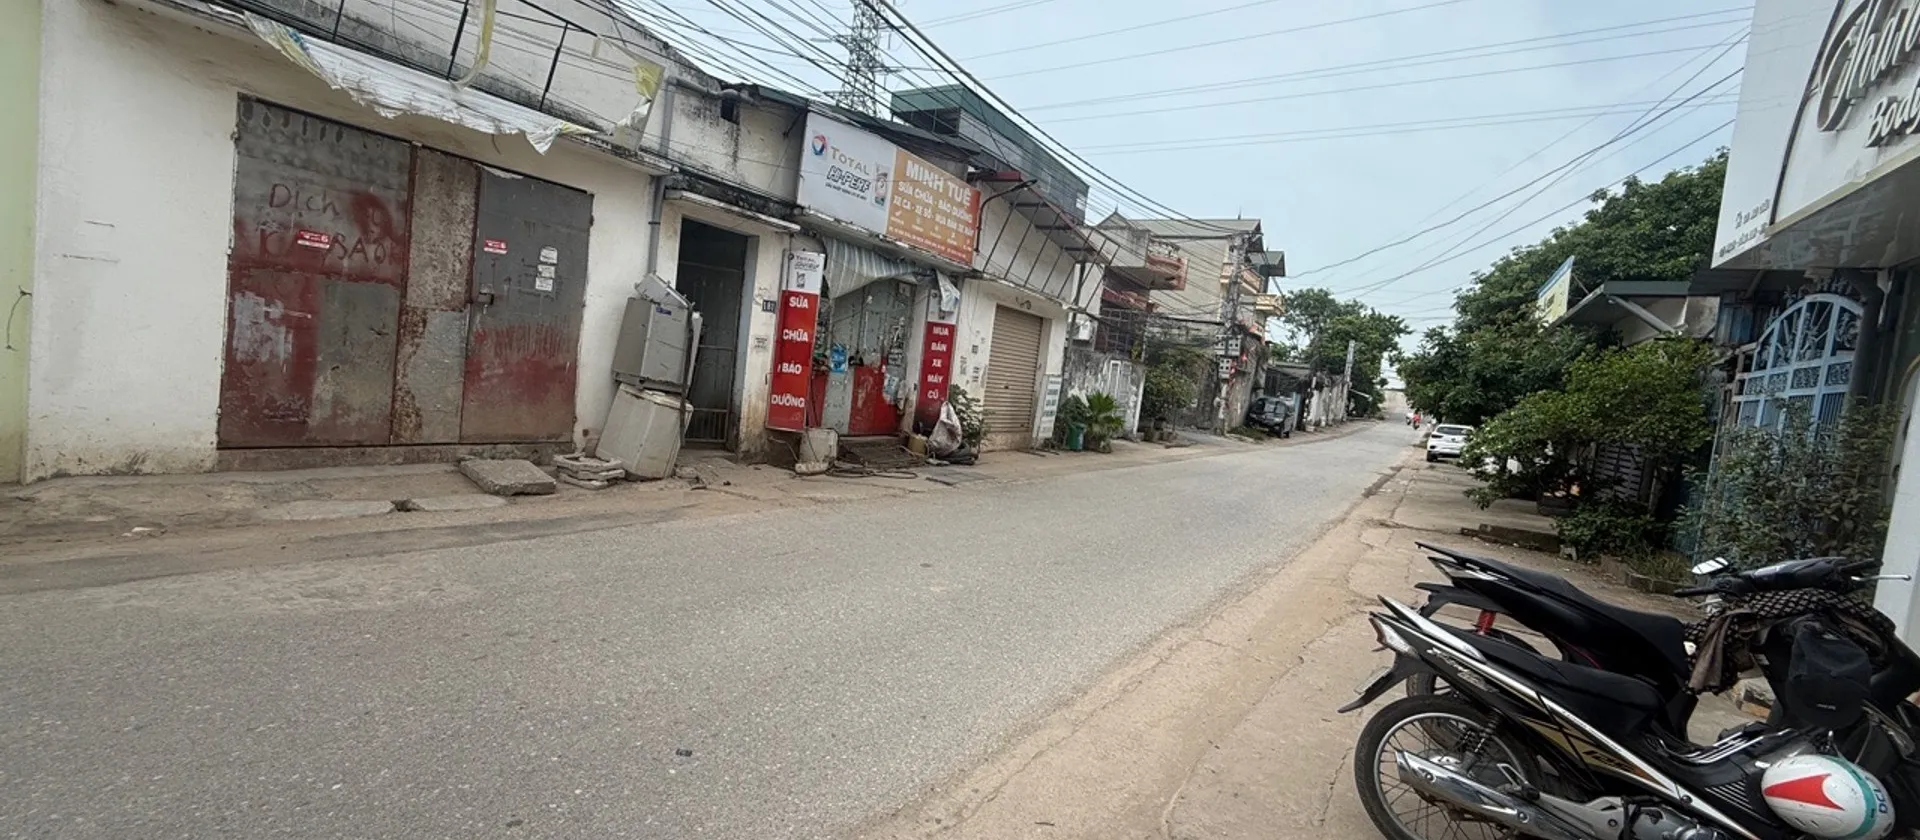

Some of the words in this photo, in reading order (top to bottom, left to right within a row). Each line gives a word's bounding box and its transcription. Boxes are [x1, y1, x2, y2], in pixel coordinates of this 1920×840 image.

[830, 146, 870, 175] TOTAL
[905, 160, 945, 193] MINH
[947, 180, 972, 209] TUỆ
[789, 295, 809, 309] SỬA
[783, 328, 809, 343] CHỮA
[932, 326, 949, 336] MUA
[931, 340, 947, 352] BÁN
[931, 359, 943, 368] XE
[927, 374, 943, 384] MÁY
[771, 393, 806, 408] DƯỠNG
[927, 390, 939, 400] CŨ
